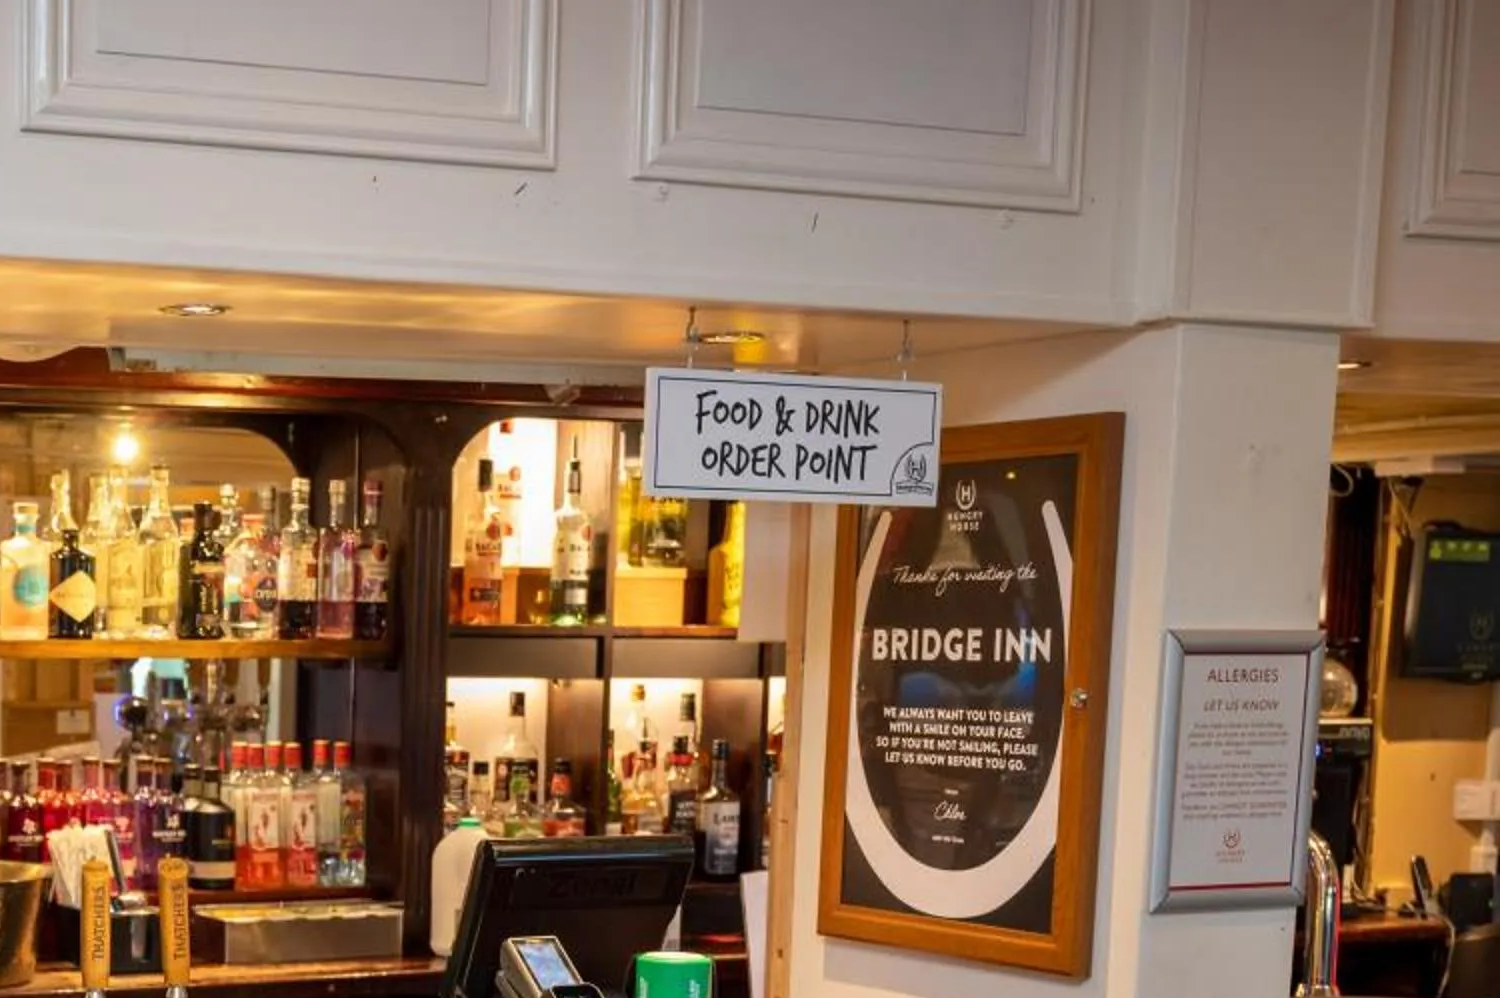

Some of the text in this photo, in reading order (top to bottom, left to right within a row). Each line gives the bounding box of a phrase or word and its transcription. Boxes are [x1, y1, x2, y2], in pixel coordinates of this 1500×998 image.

[696, 390, 880, 438] FOOD & DRINK
[701, 441, 878, 484] ORDER POINT
[935, 566, 960, 597] for
[1017, 561, 1038, 580] the
[872, 628, 1052, 663] BRIDGE INN
[1207, 668, 1279, 683] ALLERGIES
[883, 707, 1035, 724] WE ALWAYS WANT YOU TO LEAVE
[1203, 699, 1222, 712] LET
[1225, 700, 1240, 711] US
[889, 722, 913, 734] WITH
[914, 724, 921, 734] A
[923, 724, 949, 735] SMILE
[951, 725, 967, 737] ON
[969, 725, 996, 738] YOUR
[876, 736, 889, 747] SO
[891, 737, 900, 748] IF
[901, 737, 935, 750] YOU'RE
[937, 739, 957, 751] NOT
[1003, 743, 1039, 756] PLEASE
[885, 752, 900, 763] LET
[902, 753, 915, 764] US
[916, 753, 945, 765] KNOW
[947, 755, 983, 769] BEFORE
[985, 757, 1006, 770] YOU
[92, 885, 106, 960] THATCHERS
[174, 883, 189, 960] THATCHERS
